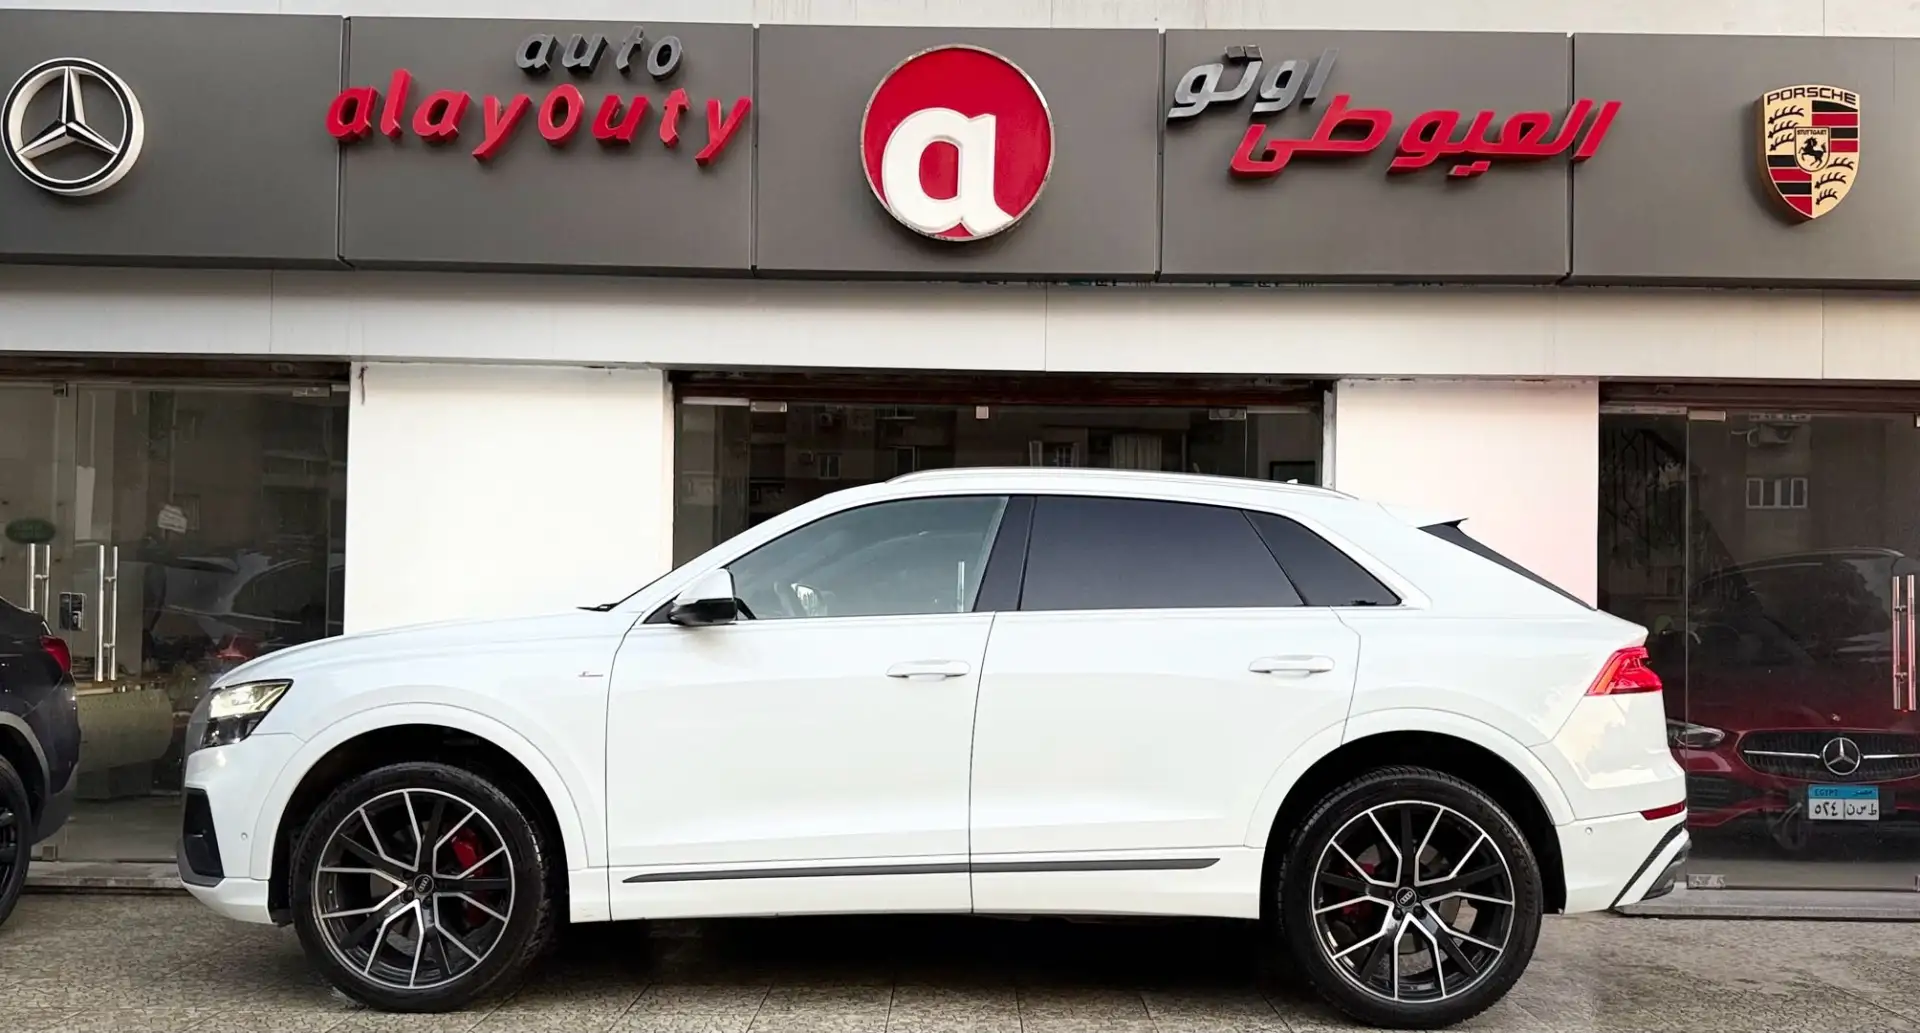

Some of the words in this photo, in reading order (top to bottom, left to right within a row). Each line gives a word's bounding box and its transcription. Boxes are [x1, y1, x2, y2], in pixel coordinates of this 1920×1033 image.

[516, 25, 684, 81] auto
[1166, 44, 1339, 122] اوتو
[325, 68, 752, 166] alayouty
[1766, 87, 1857, 105] PORSCHE
[882, 107, 1015, 237] a
[1814, 788, 1838, 797] EGYPT
